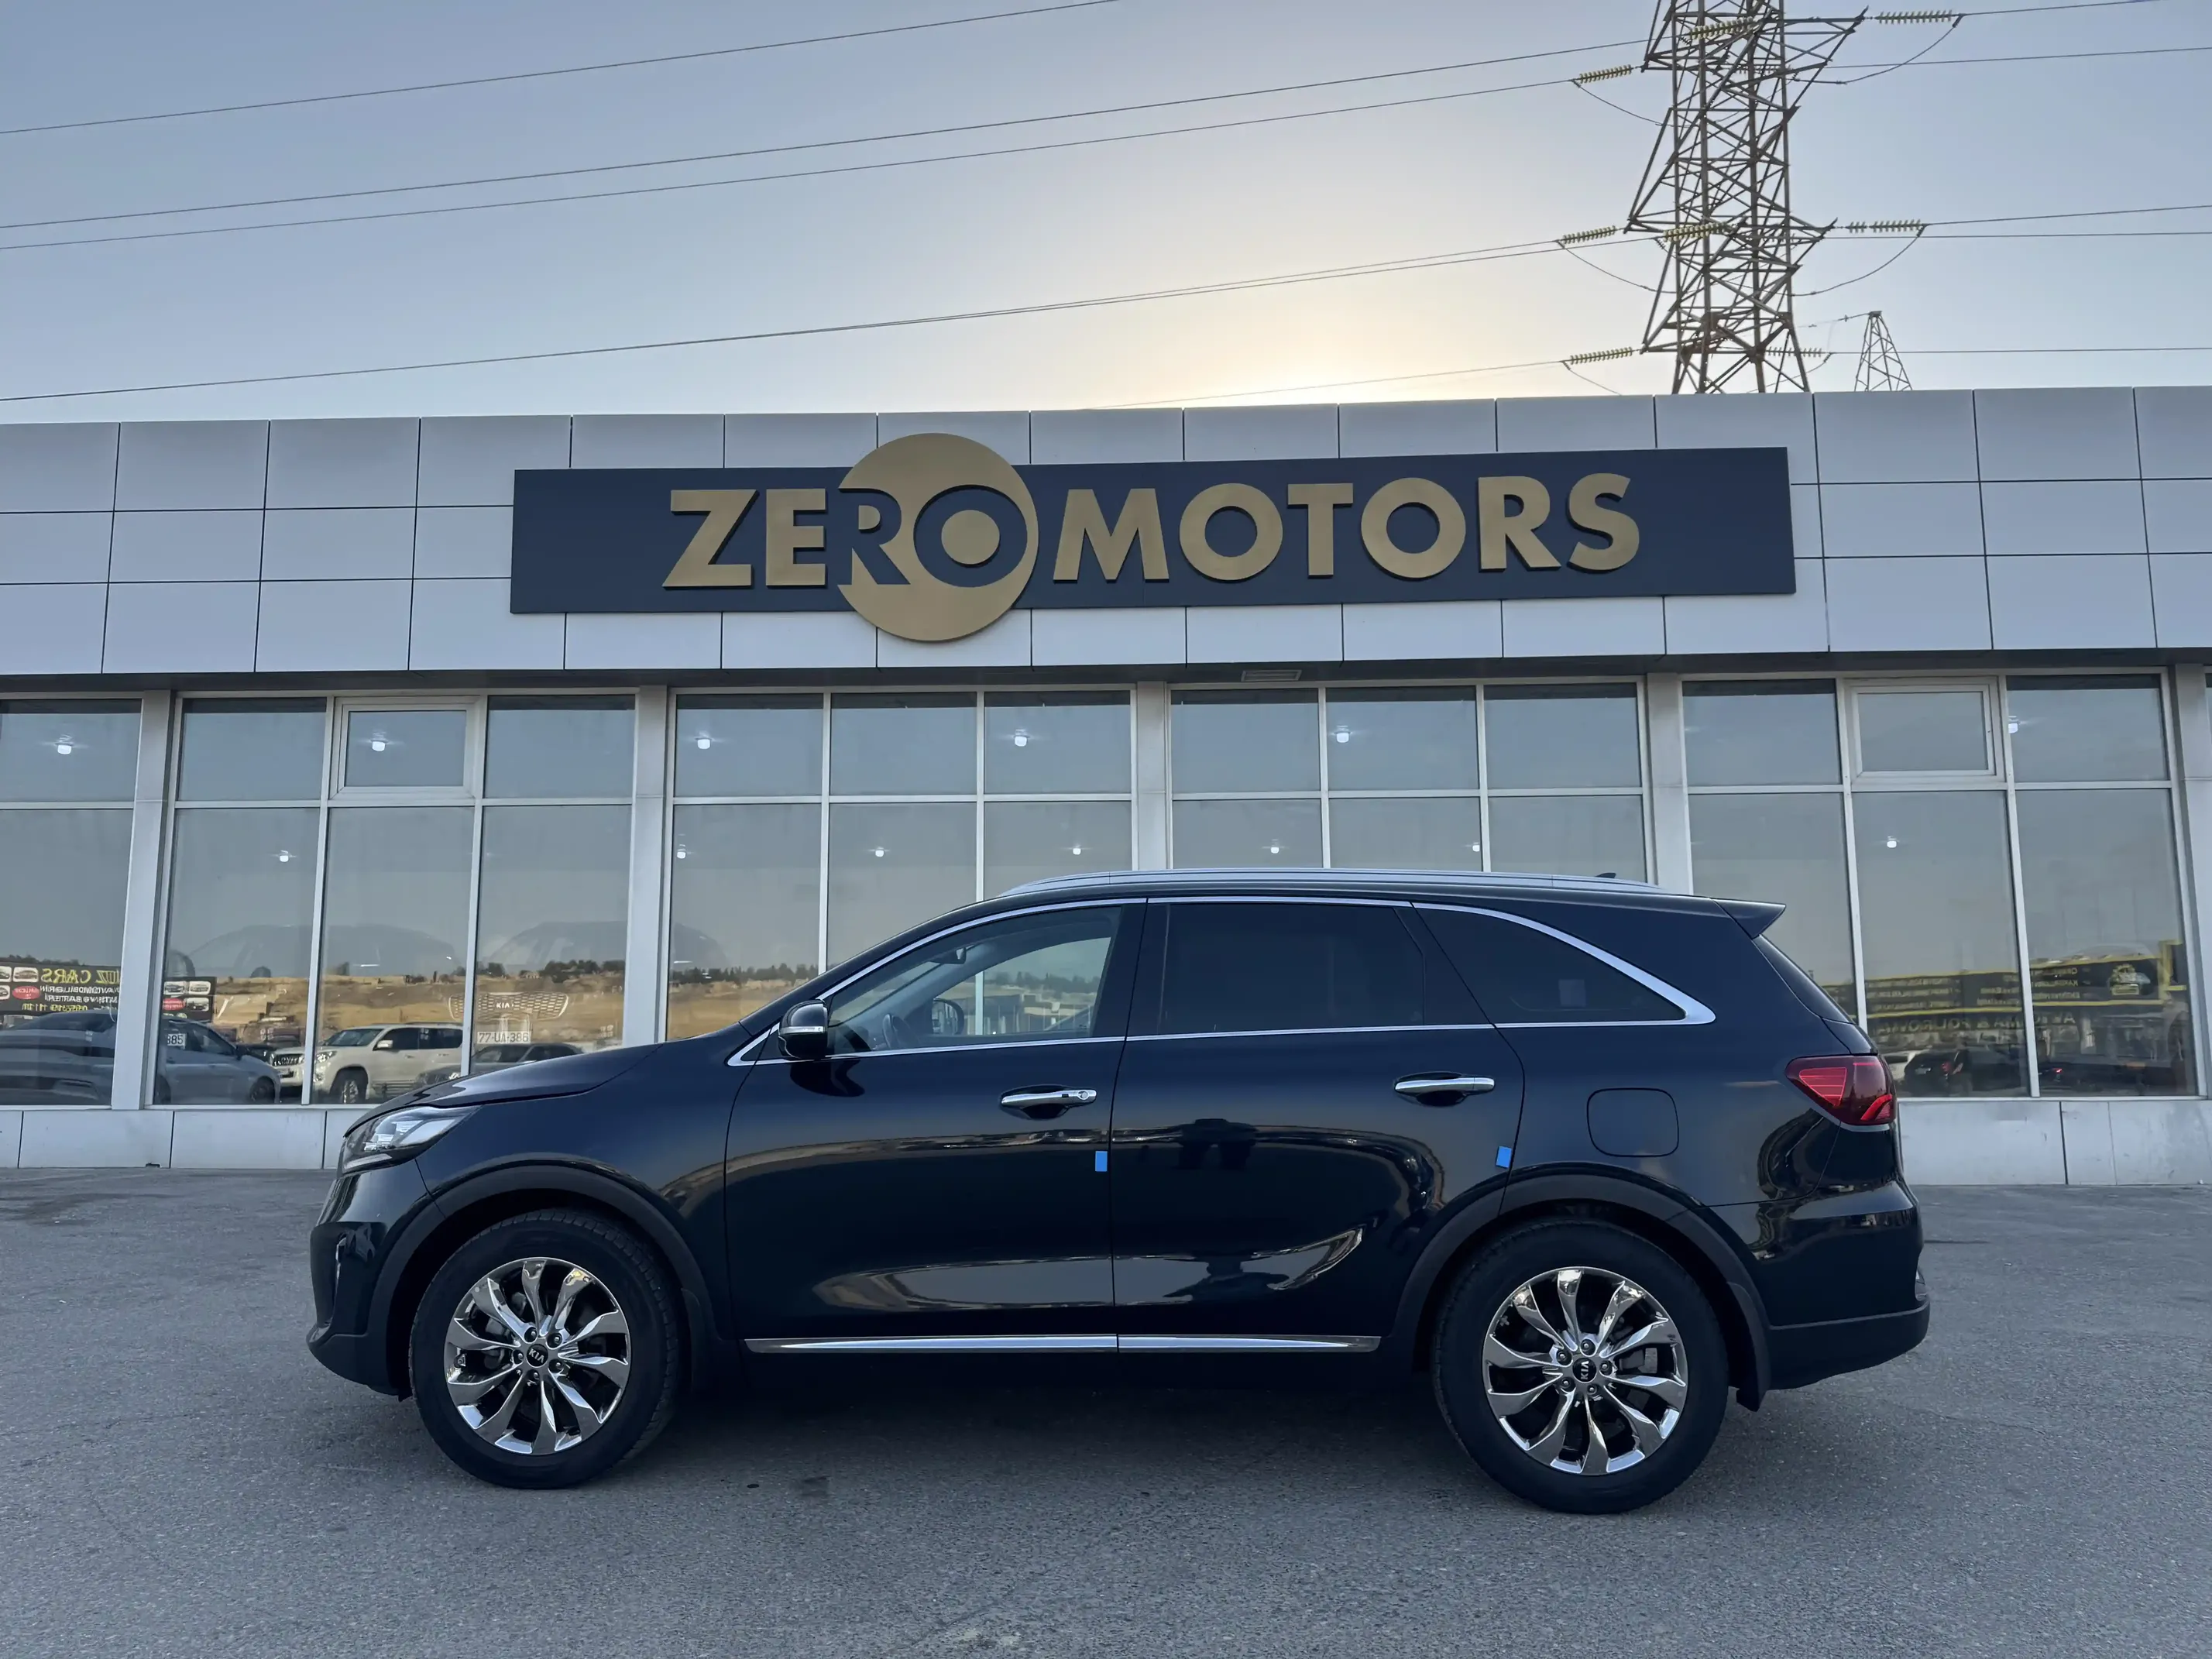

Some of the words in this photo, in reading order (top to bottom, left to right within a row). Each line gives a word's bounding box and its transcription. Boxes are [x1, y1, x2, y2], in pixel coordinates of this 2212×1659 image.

[661, 484, 1029, 589] ZERO
[1052, 472, 1640, 582] MOTORS
[479, 1032, 529, 1042] 77-UA-386
[528, 1348, 544, 1363] KIA
[1581, 1360, 1589, 1380] KIA
